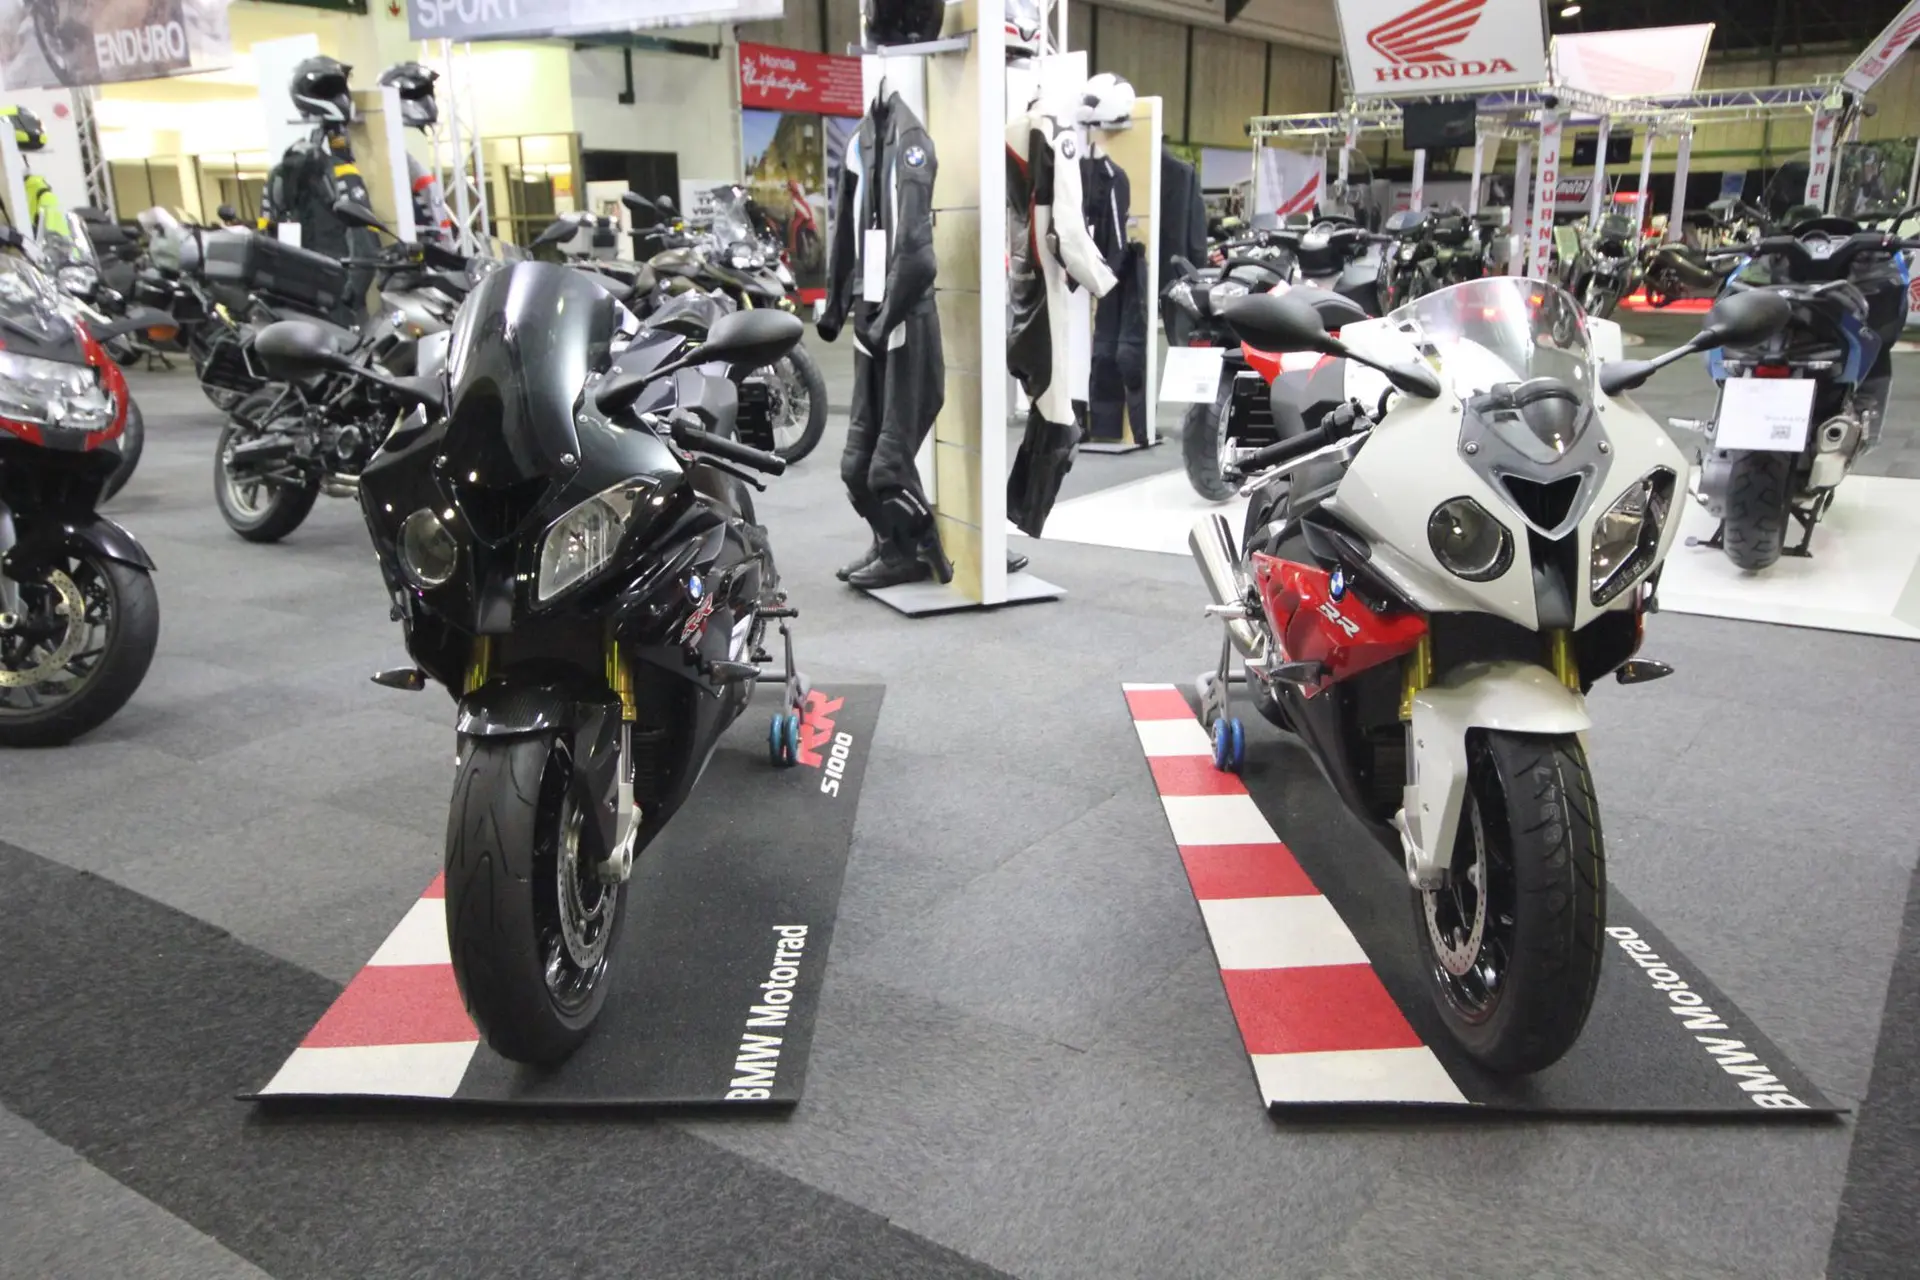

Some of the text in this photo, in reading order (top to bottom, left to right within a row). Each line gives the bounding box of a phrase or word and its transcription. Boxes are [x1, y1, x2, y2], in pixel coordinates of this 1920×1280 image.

[94, 21, 185, 68] ENDURO
[1373, 58, 1518, 82] HONDA
[1537, 150, 1556, 276] JOURNEY
[1317, 602, 1360, 638] RR
[820, 731, 853, 798] S1000
[724, 925, 808, 1100] BMW Motorrad
[1605, 927, 1811, 1109] BMW Motorrad
